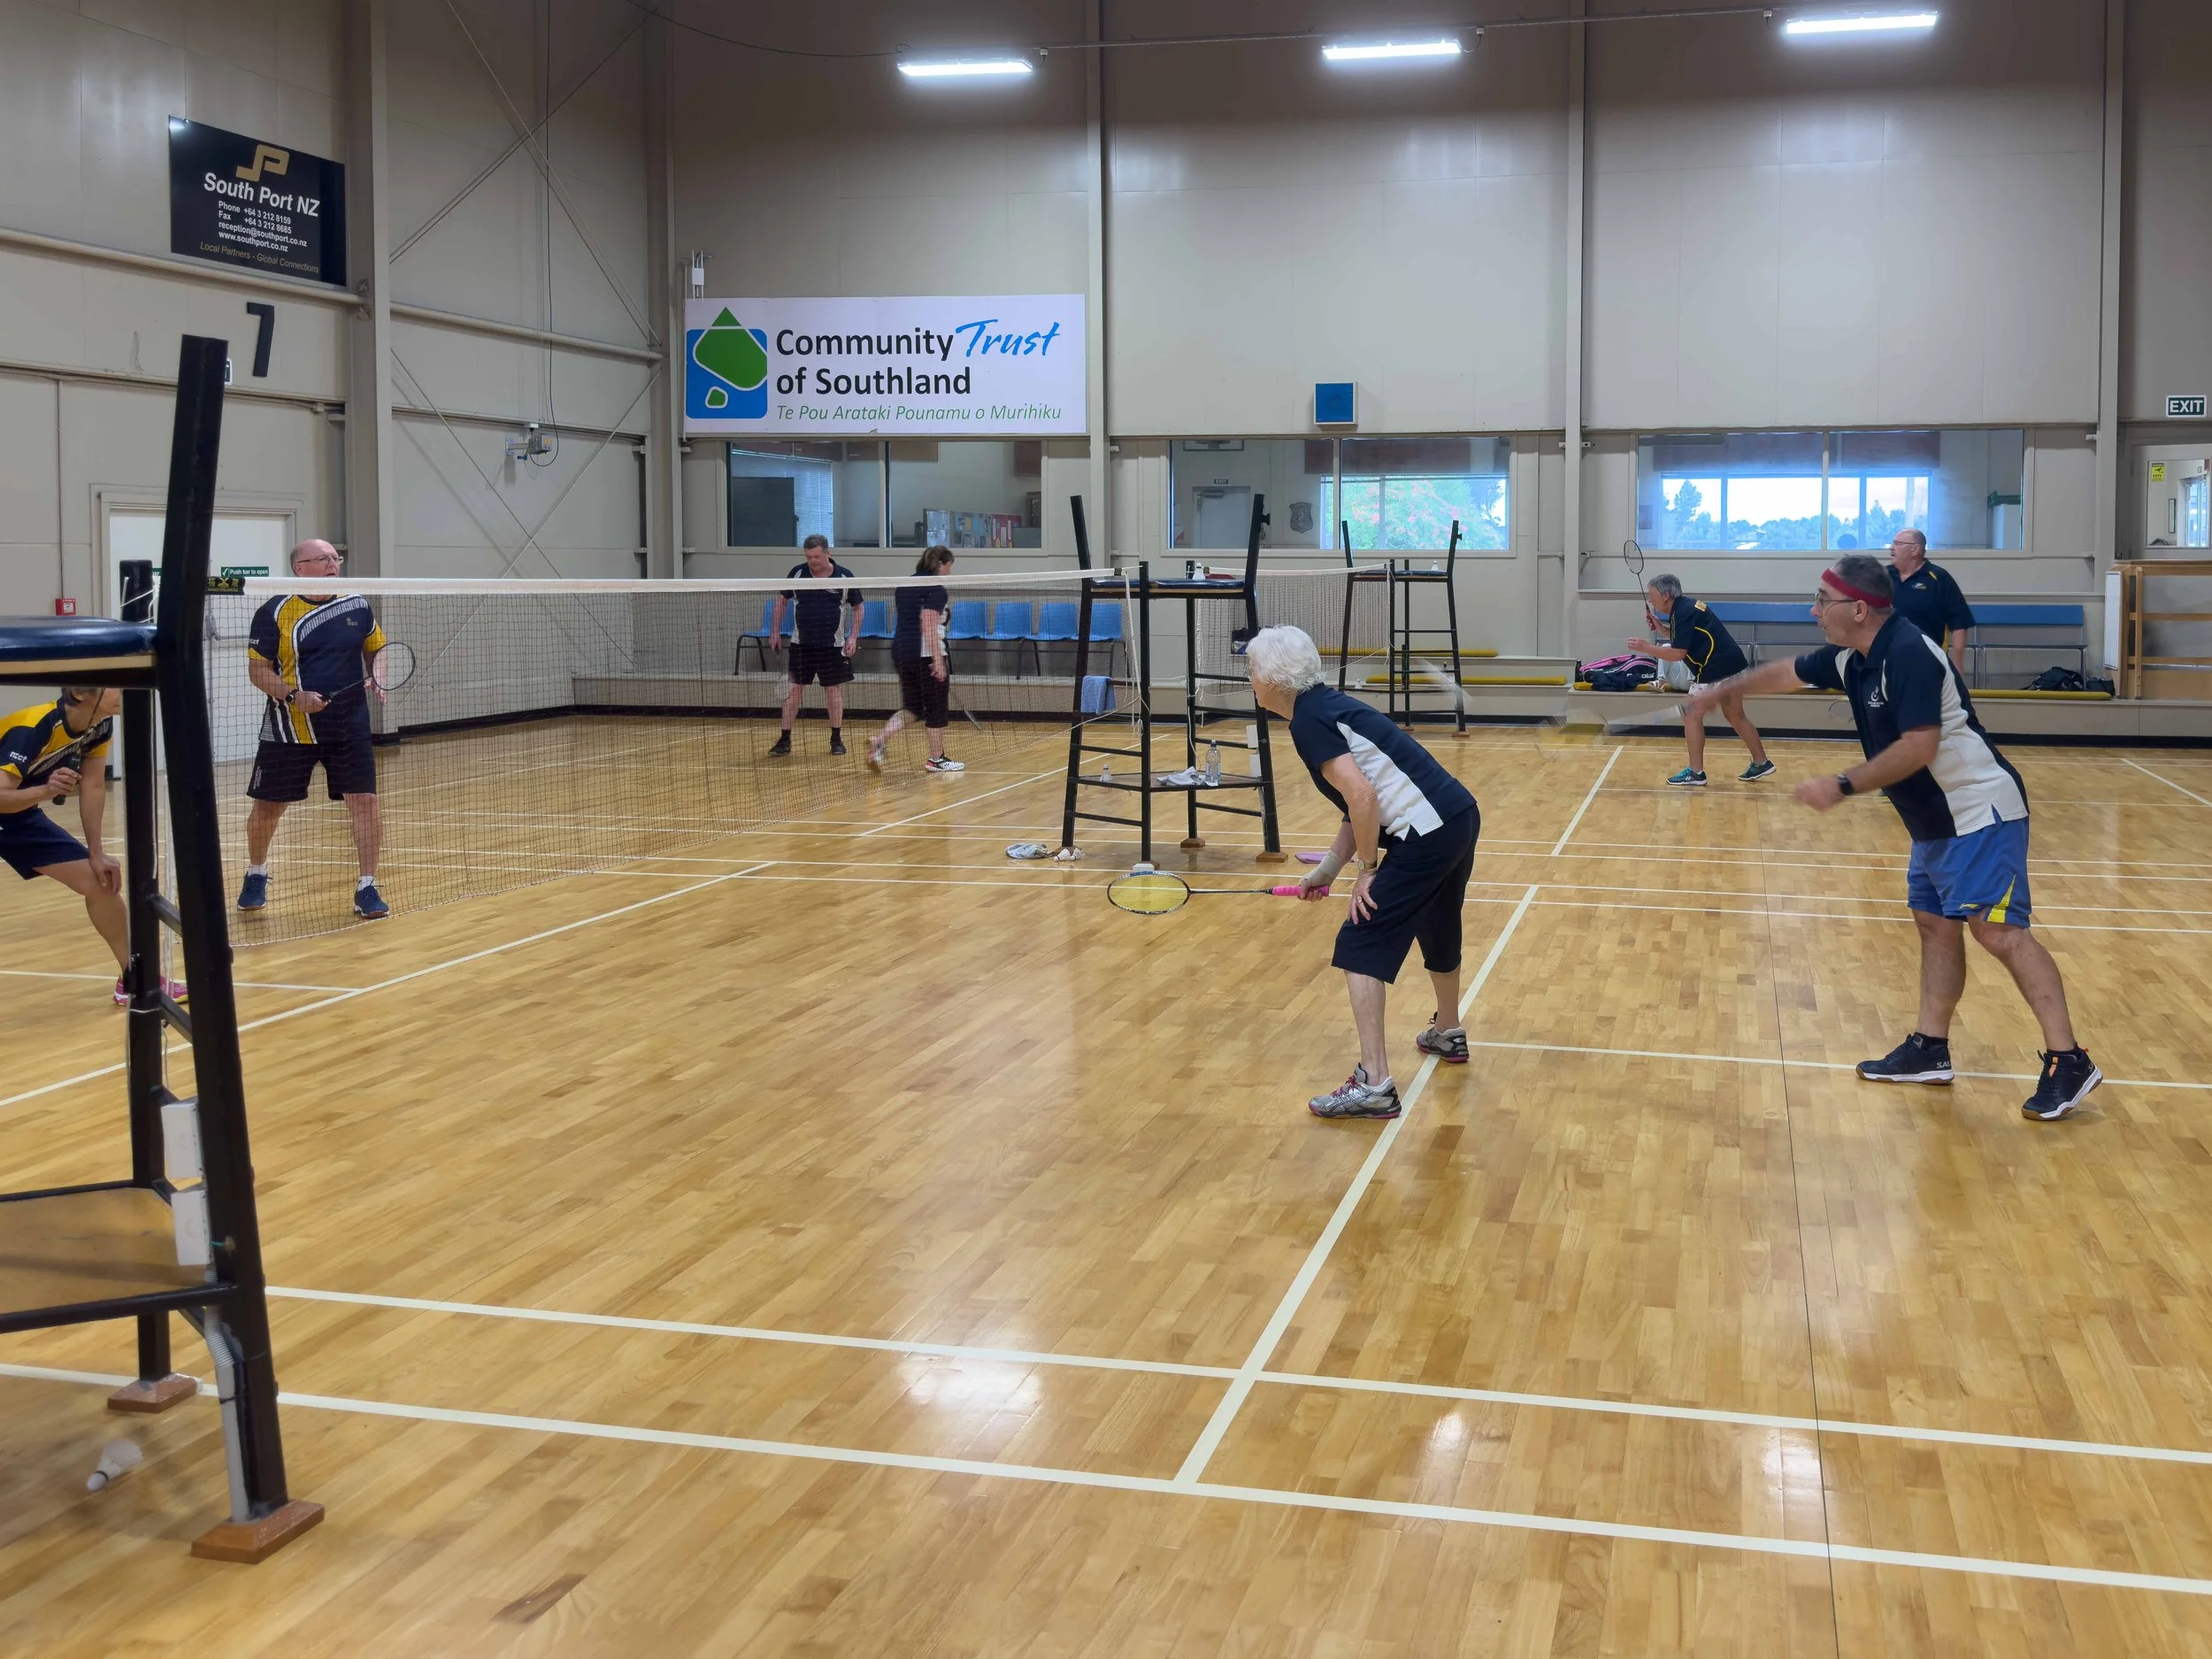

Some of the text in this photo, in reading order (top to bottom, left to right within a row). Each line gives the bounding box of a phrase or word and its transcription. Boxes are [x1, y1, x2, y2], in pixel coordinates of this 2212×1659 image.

[204, 172, 320, 218] South Port NZ
[219, 200, 241, 213] Phone
[243, 207, 256, 217] +64
[263, 211, 274, 221] 212
[275, 214, 291, 225] 8159
[219, 211, 231, 220] Fax
[244, 217, 257, 227] +64
[263, 220, 275, 231] 212
[219, 221, 308, 247] reception@southport.co.nz
[219, 231, 288, 252] www.southport.co.nz
[200, 241, 219, 253] Local
[221, 245, 250, 259] Partners
[257, 253, 279, 265] Global
[279, 257, 319, 273] Connections
[246, 302, 275, 378] 7
[776, 319, 1061, 361] Community Trust
[777, 366, 971, 395] of Southland
[777, 403, 1061, 420] Te Pou Arataki Pounamu o Murihiku
[2170, 400, 2203, 412] EXIT
